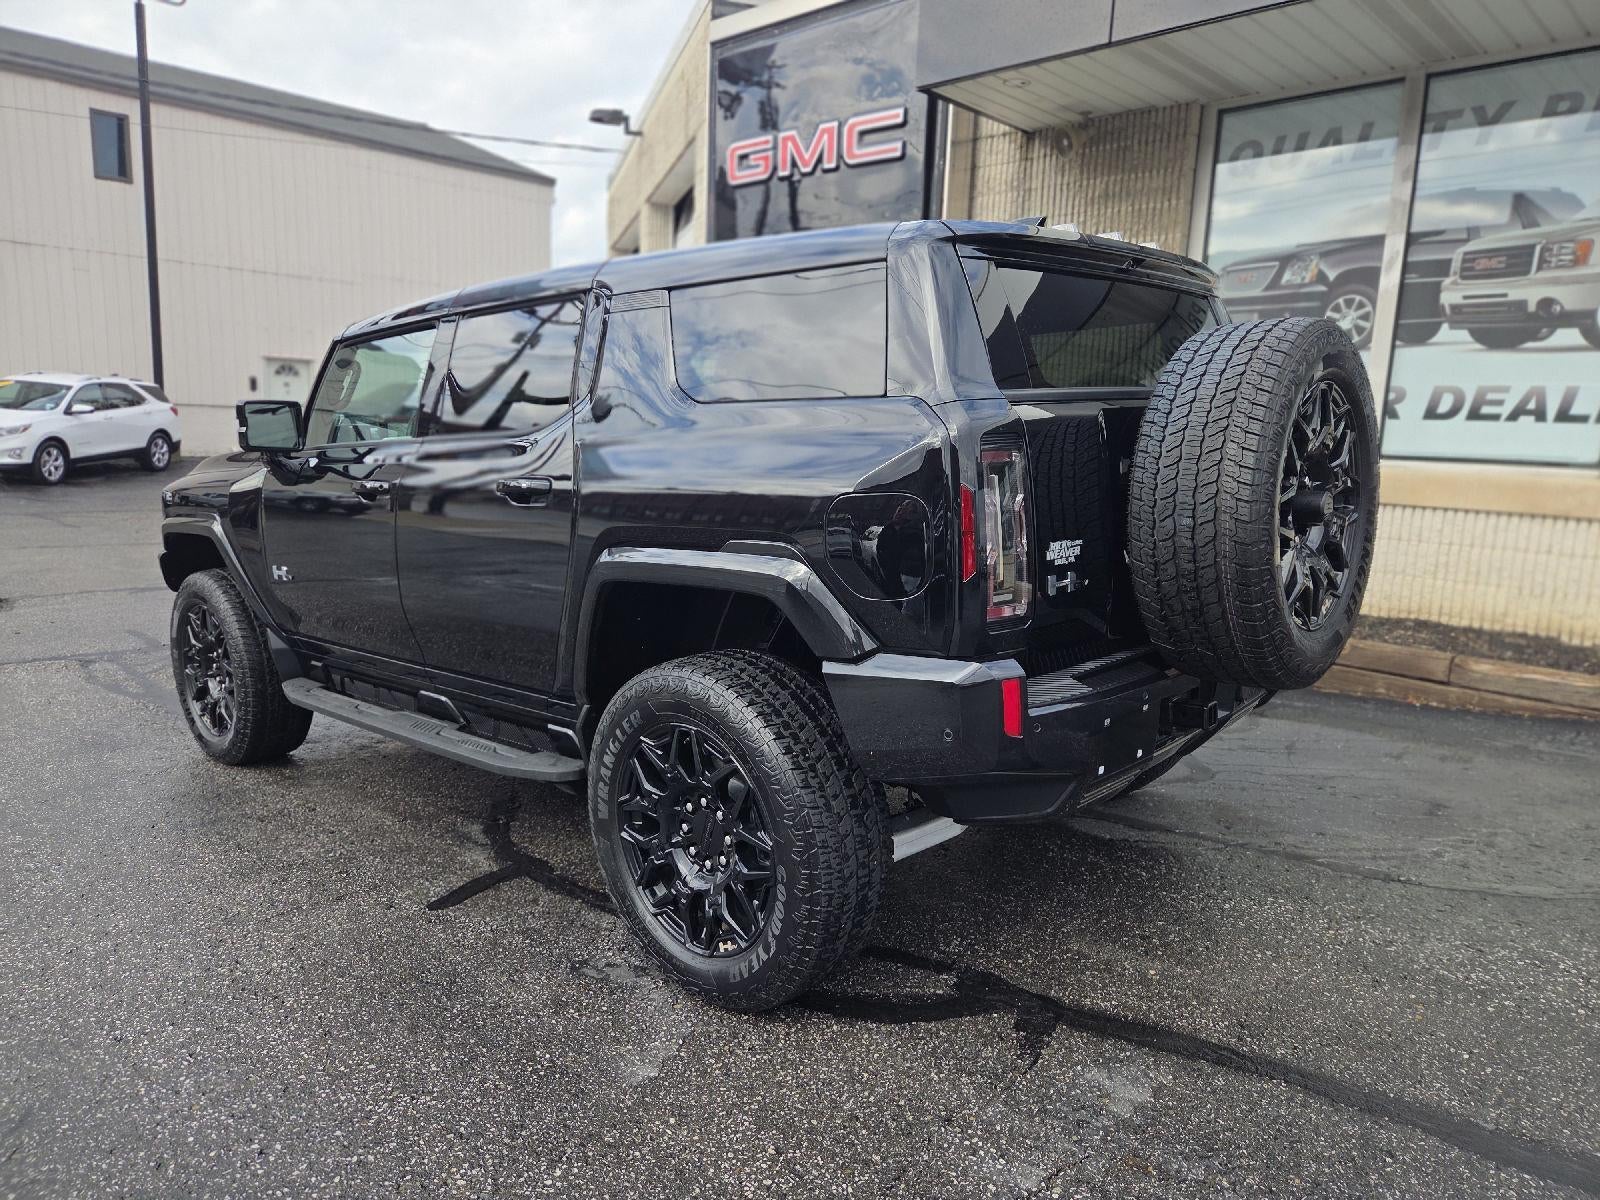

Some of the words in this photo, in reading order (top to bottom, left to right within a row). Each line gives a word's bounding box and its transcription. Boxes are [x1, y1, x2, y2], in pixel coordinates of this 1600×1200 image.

[727, 107, 906, 187] GMC
[1226, 99, 1518, 177] QUALTY
[1422, 385, 1600, 424] DEAL
[1045, 546, 1081, 561] WEAVER
[597, 708, 642, 820] WRANGLER
[728, 864, 788, 983] GOODYEAR
